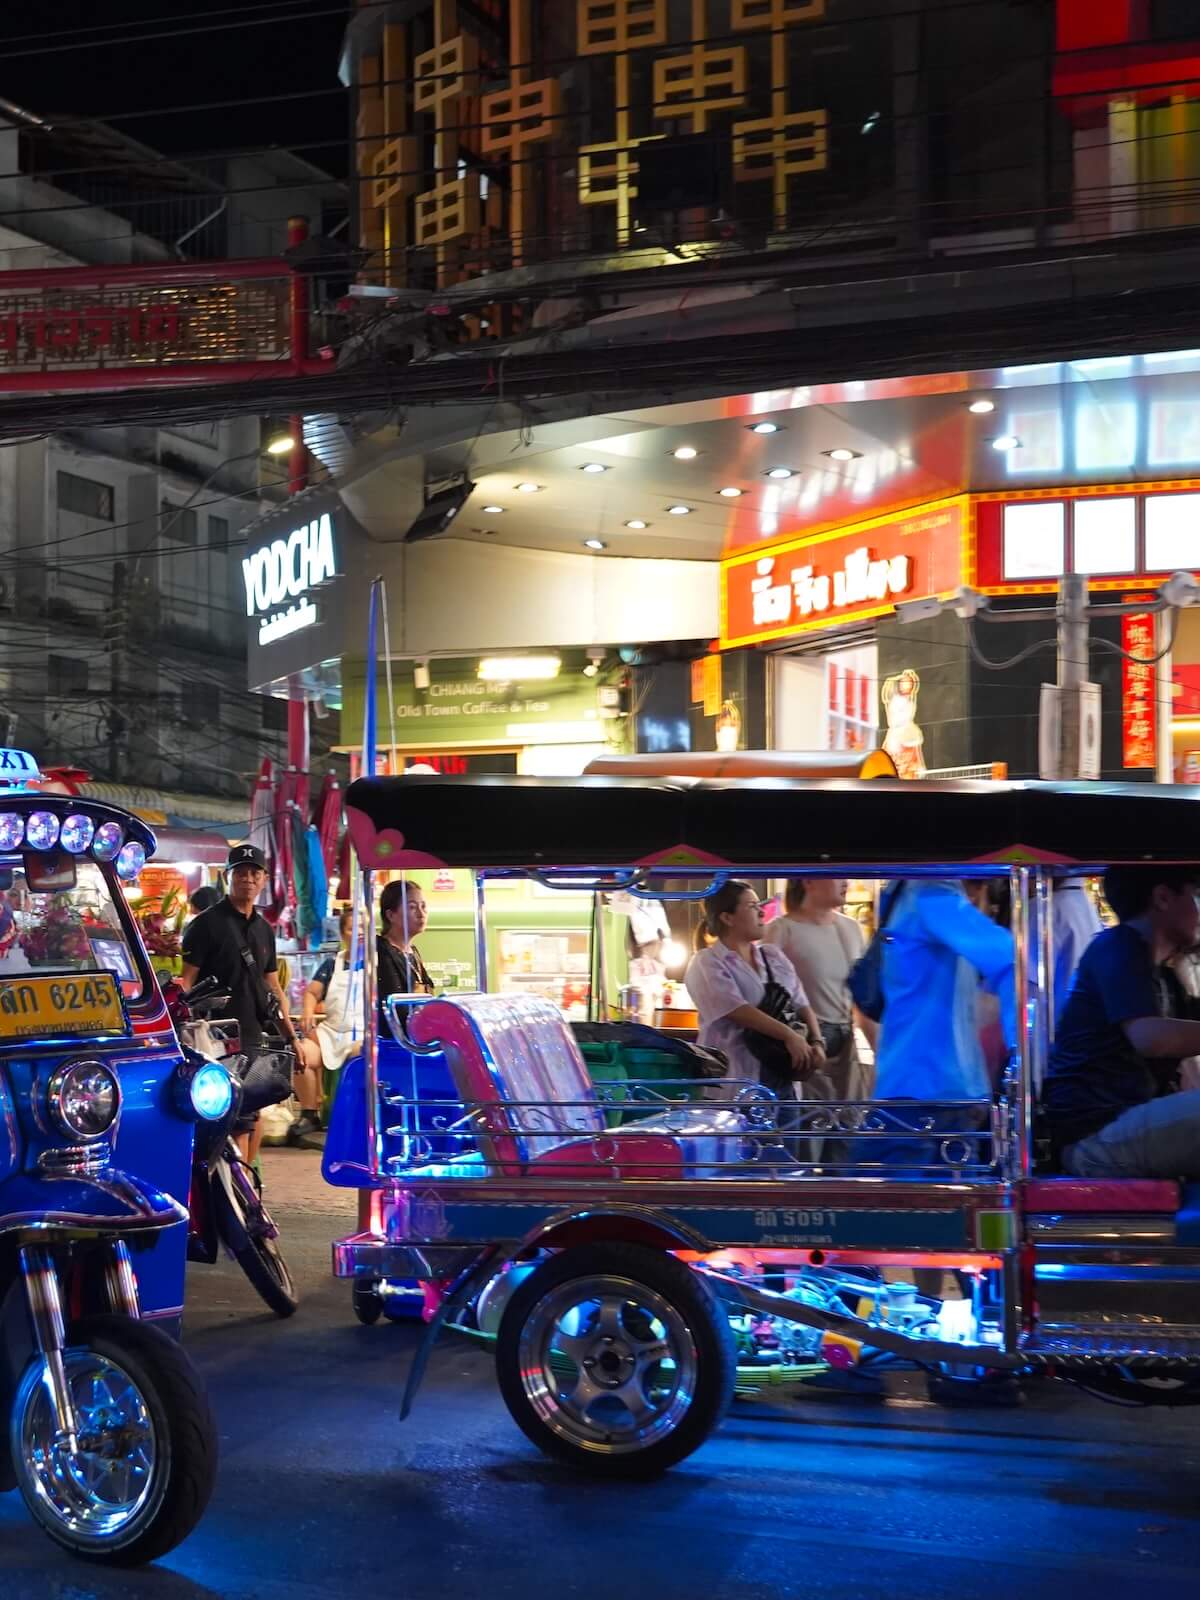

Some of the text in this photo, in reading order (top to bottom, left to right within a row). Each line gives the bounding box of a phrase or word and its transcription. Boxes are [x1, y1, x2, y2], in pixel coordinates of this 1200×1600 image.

[242, 513, 335, 616] YODCHA
[430, 683, 484, 697] CHIANG
[397, 705, 421, 718] Old
[424, 704, 460, 716] Town
[462, 702, 507, 714] Coffee
[49, 981, 112, 1010] 6245
[783, 1211, 837, 1227] 5091
